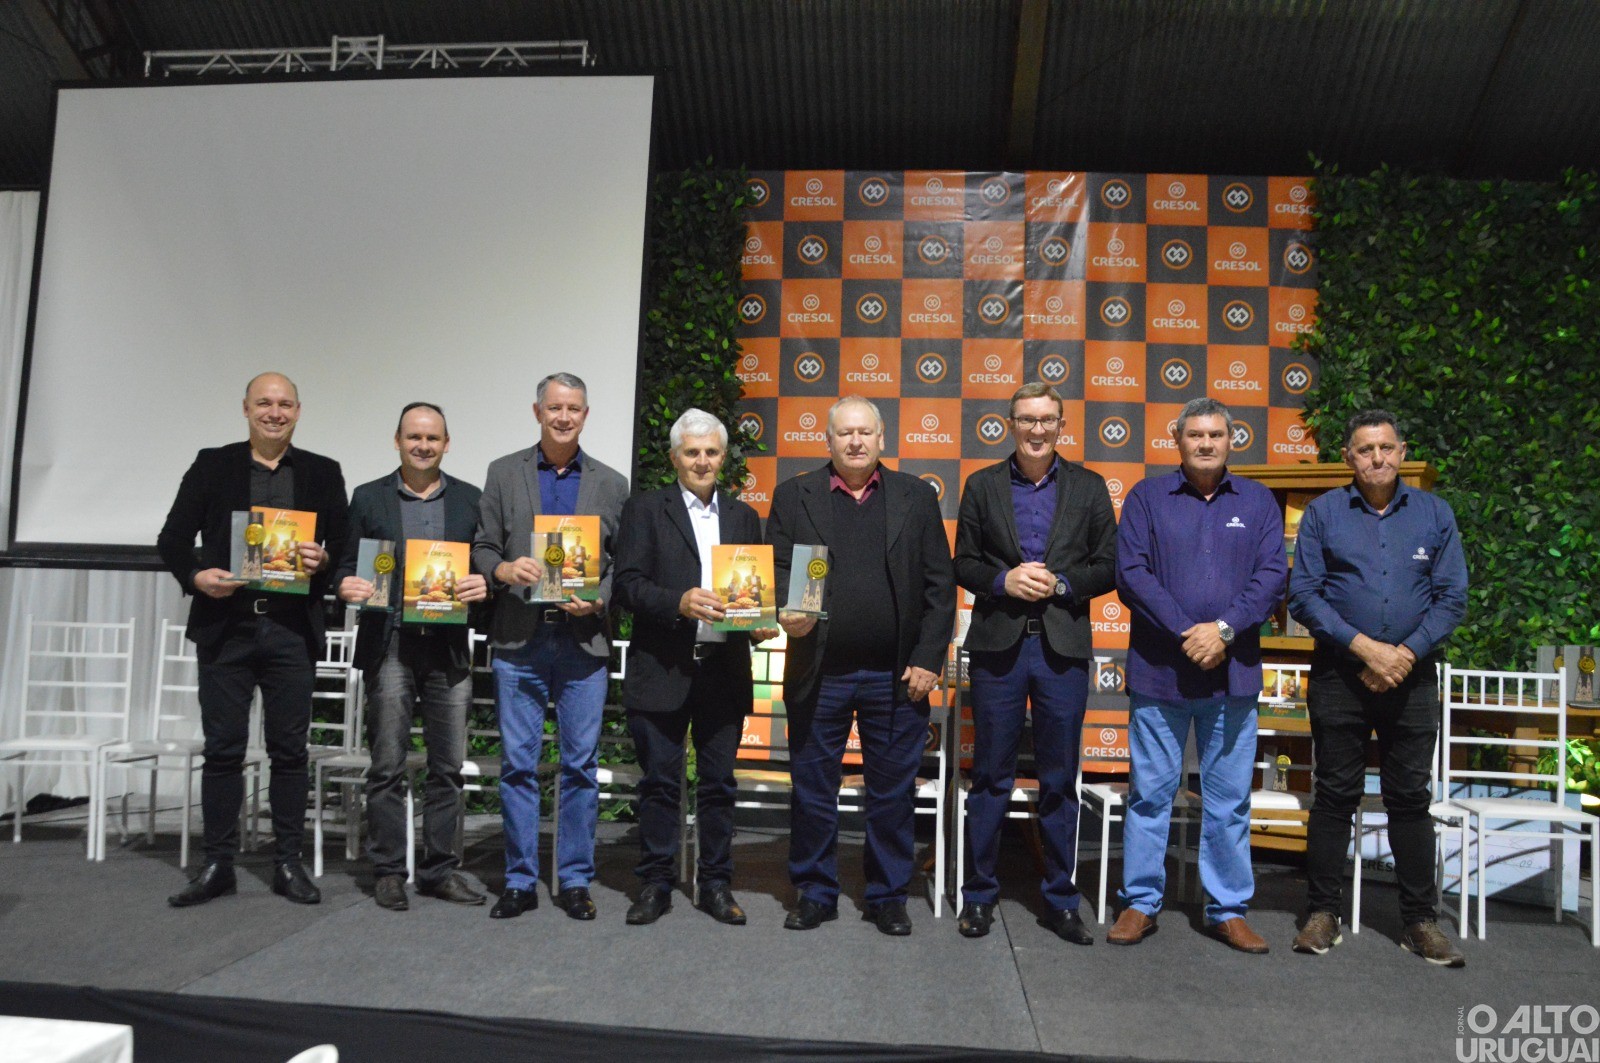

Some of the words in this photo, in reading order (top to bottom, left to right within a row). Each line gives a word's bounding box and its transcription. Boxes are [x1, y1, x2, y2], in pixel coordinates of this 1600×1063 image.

[791, 197, 837, 206] CRESOL
[911, 196, 957, 206] CRESOL
[1032, 197, 1078, 207] CRESOL
[1153, 200, 1200, 211] CRESOL
[741, 255, 775, 265] RESOL
[849, 254, 896, 264] CRESOL
[970, 255, 1016, 264] CRESOL
[1093, 257, 1139, 267] CRESOL
[1214, 261, 1261, 271] CRESOL
[787, 314, 834, 323] CRESOL
[908, 314, 956, 323] CRESOL
[1030, 315, 1078, 324] CRESOL
[1153, 318, 1200, 329] CRESOL
[1275, 322, 1313, 333] CRESO
[736, 373, 772, 382] RESOL
[846, 373, 893, 382] CRESOL
[969, 374, 1016, 384] CRESOL
[1091, 376, 1138, 386] CRESOL
[1214, 380, 1262, 390] CRESOL
[784, 432, 826, 442] CRESO
[906, 433, 953, 443] CRESOL
[1056, 436, 1076, 445] SOL
[1152, 439, 1176, 448] CRE
[1273, 443, 1319, 454] CRESOL
[736, 493, 769, 502] ESOL
[742, 735, 763, 744] SOL
[1084, 747, 1130, 758] CRESOL
